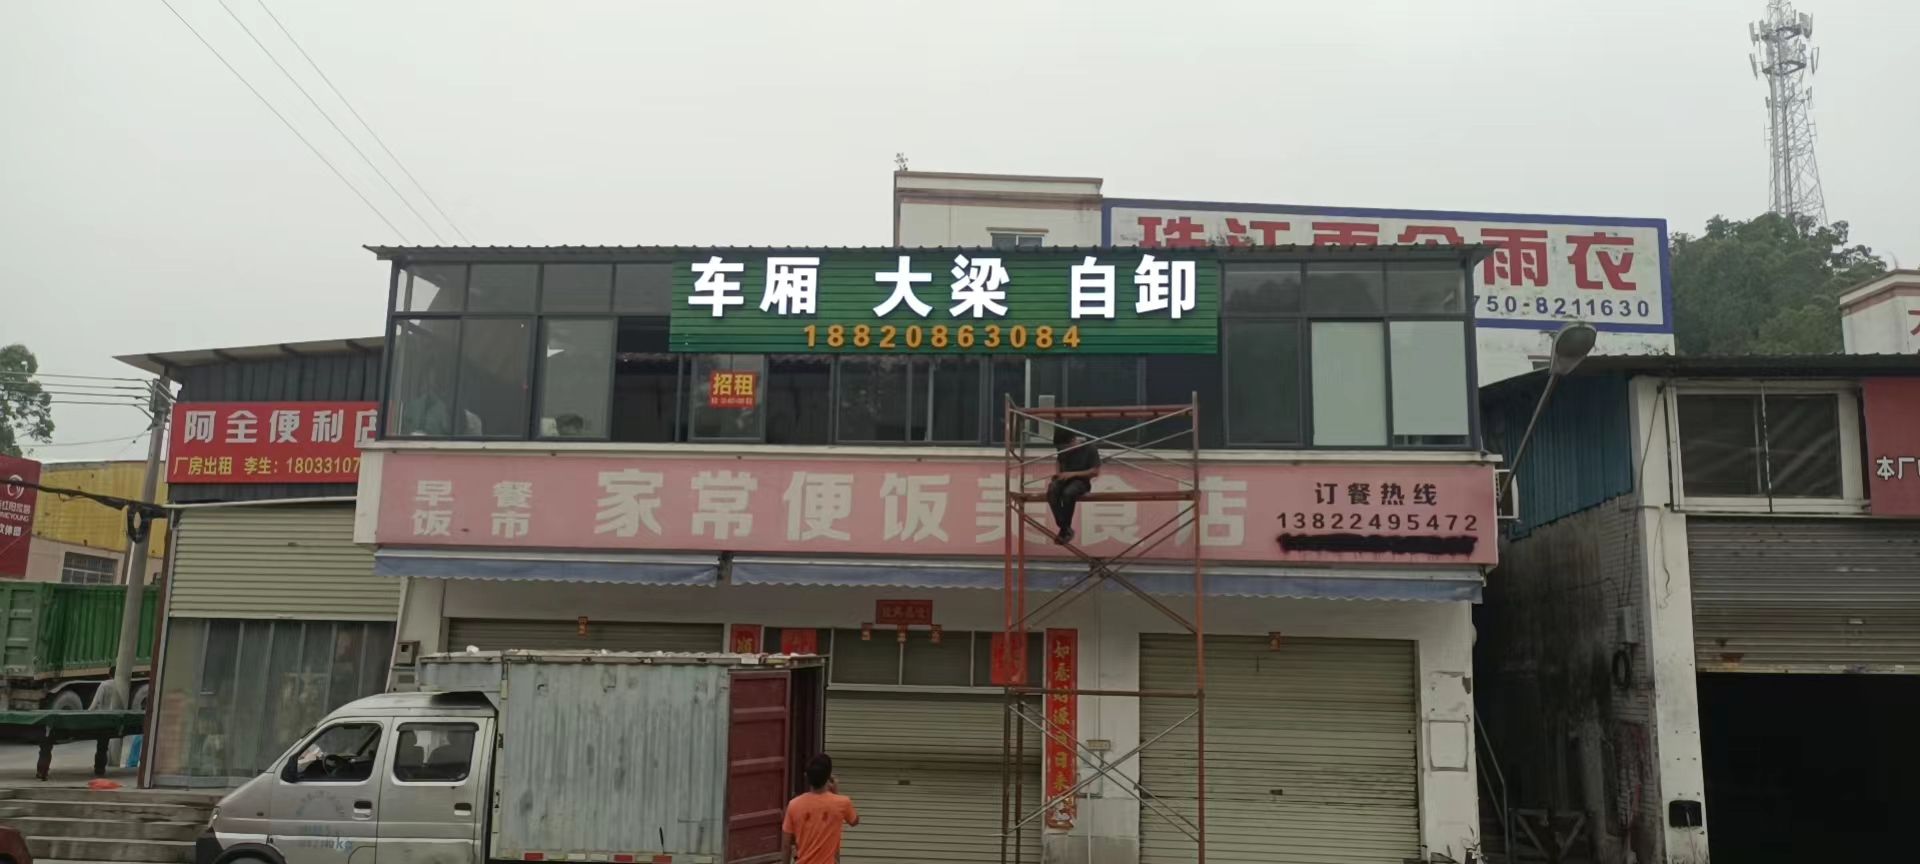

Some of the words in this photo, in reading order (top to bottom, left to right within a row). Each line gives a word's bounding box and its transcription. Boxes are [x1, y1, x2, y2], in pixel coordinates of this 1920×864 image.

[688, 254, 820, 318] 车厢
[873, 254, 1010, 319] 大梁
[1070, 253, 1197, 319] 自卸
[803, 324, 1082, 350] 18820863084
[712, 373, 753, 396] 招租
[184, 409, 377, 444] 阿全便利店
[173, 456, 233, 475] 厂房出租
[1314, 482, 1439, 507] 订餐热线
[594, 469, 1247, 547] 家常便饭美食店
[1276, 511, 1479, 533] 13822495472
